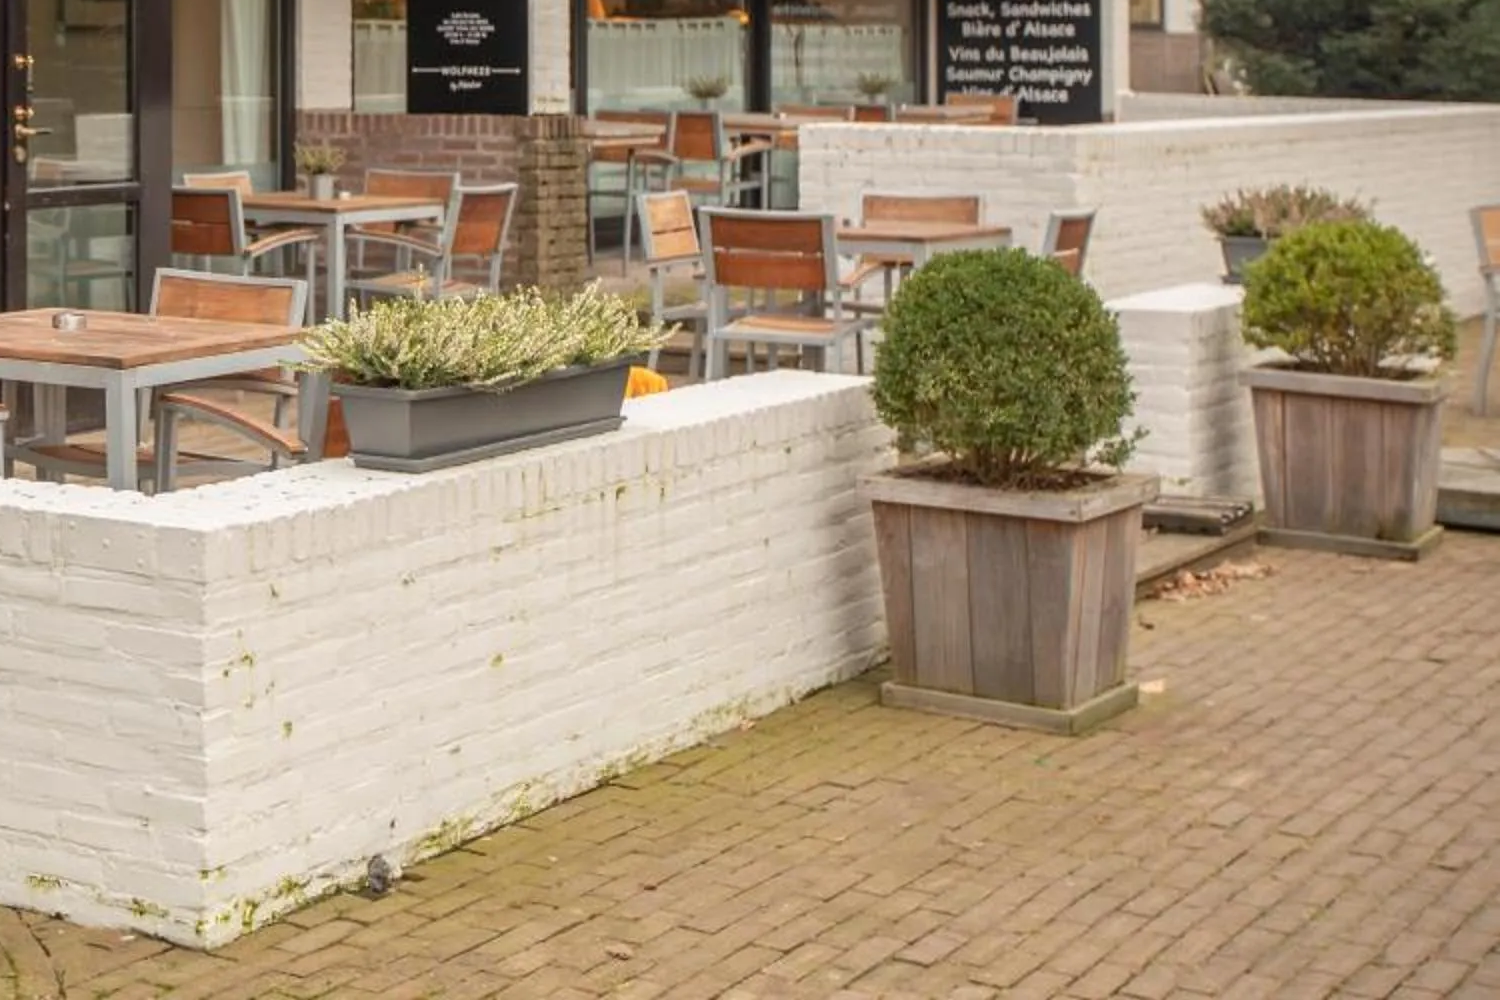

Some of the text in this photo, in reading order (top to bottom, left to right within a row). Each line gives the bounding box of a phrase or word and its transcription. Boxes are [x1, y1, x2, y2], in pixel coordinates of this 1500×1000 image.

[1001, 0, 1091, 17] Sandwiches
[962, 20, 1001, 38] Bière
[1024, 20, 1075, 37] Alsace
[948, 44, 1089, 65] Vins du Beaujolais
[946, 65, 1093, 87] Saumur Champigny
